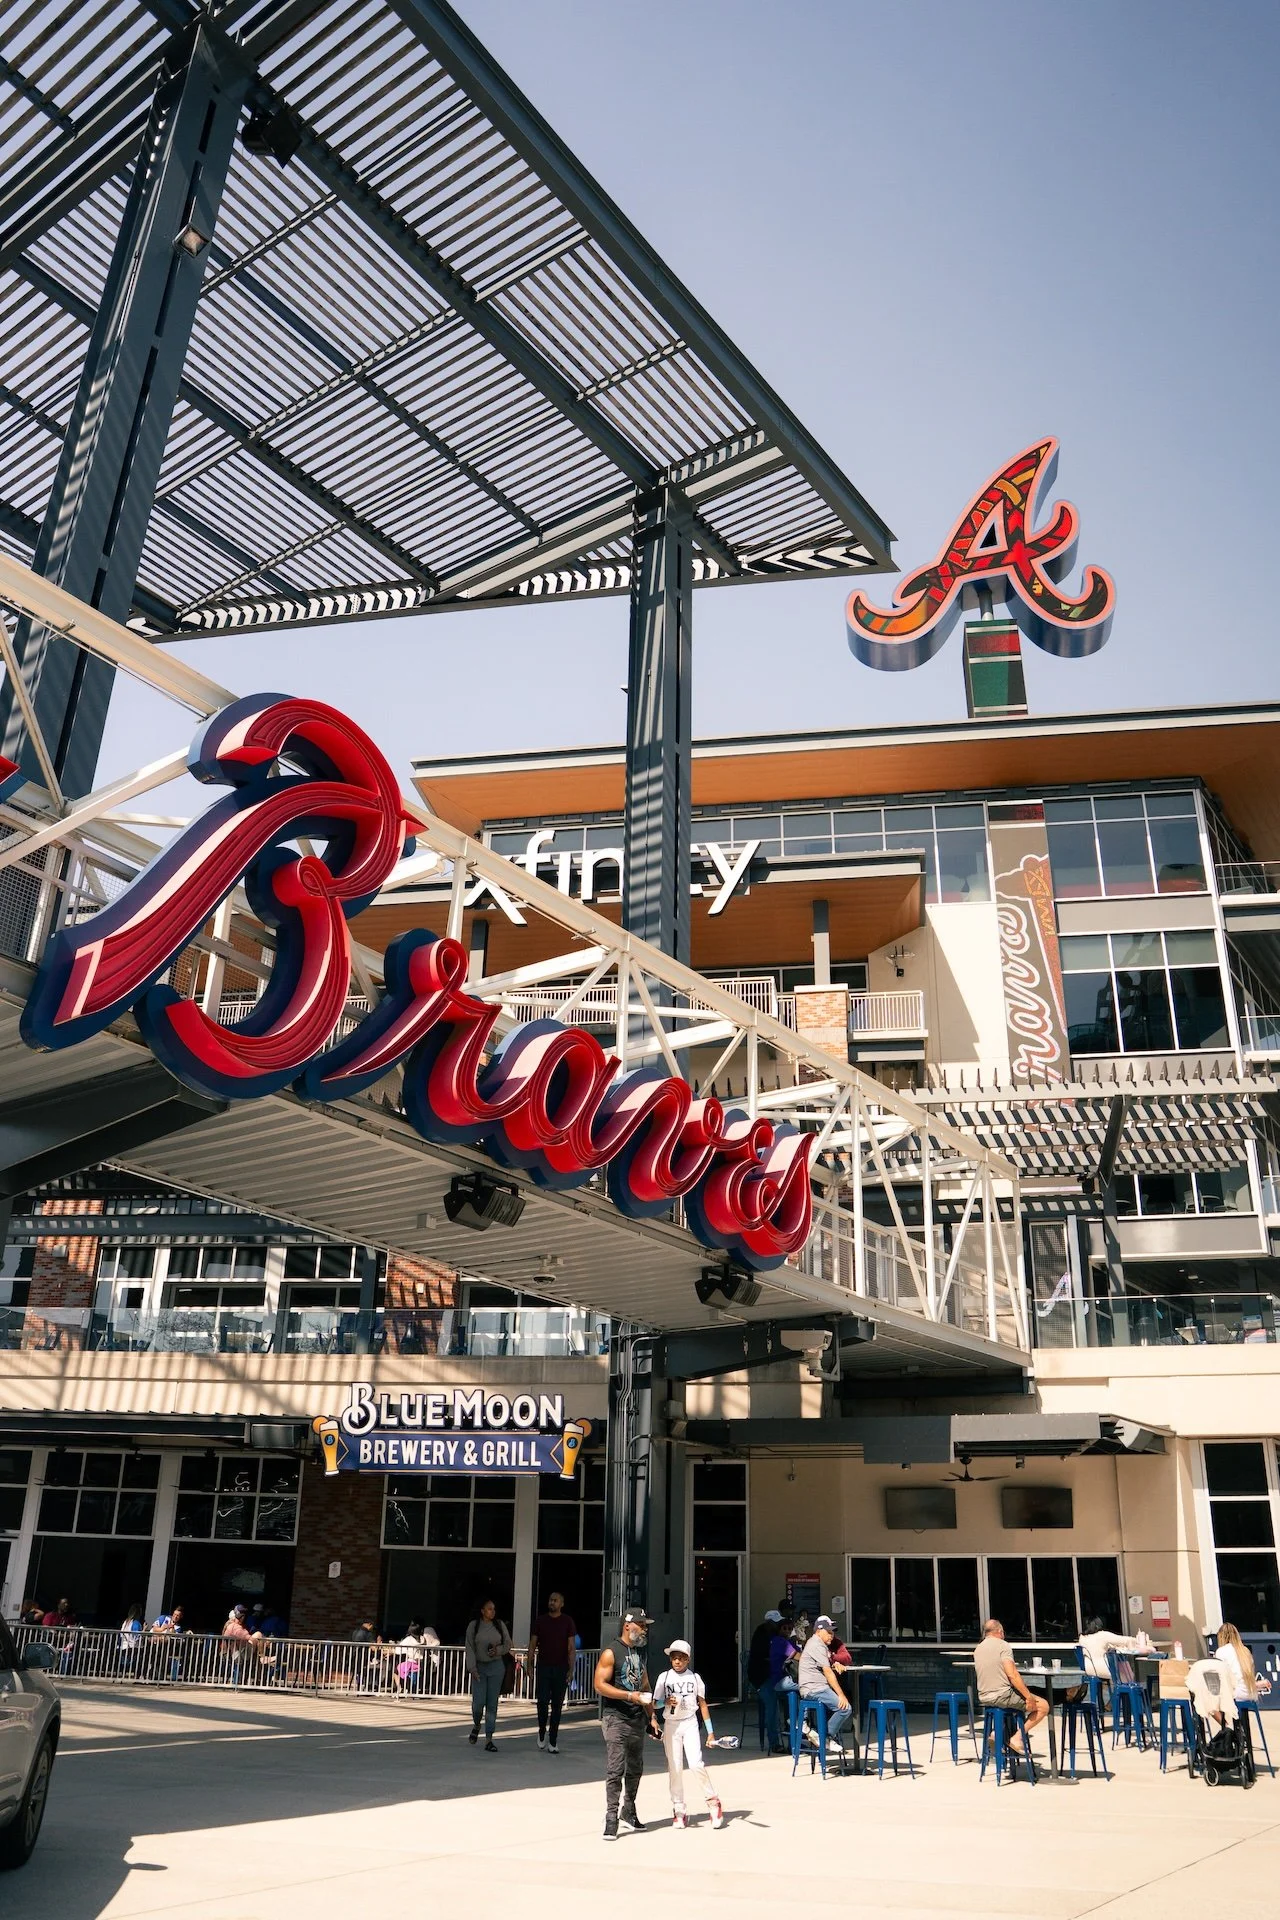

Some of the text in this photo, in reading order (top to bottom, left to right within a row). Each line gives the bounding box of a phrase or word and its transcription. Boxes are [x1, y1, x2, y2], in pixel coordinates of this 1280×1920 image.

[845, 435, 1117, 668] A
[464, 830, 762, 926] xfiny
[20, 692, 813, 1271] Braves
[997, 901, 1062, 1085] raves
[342, 1382, 564, 1436] BLUE MOON
[359, 1439, 541, 1467] BREWERY & GRILL
